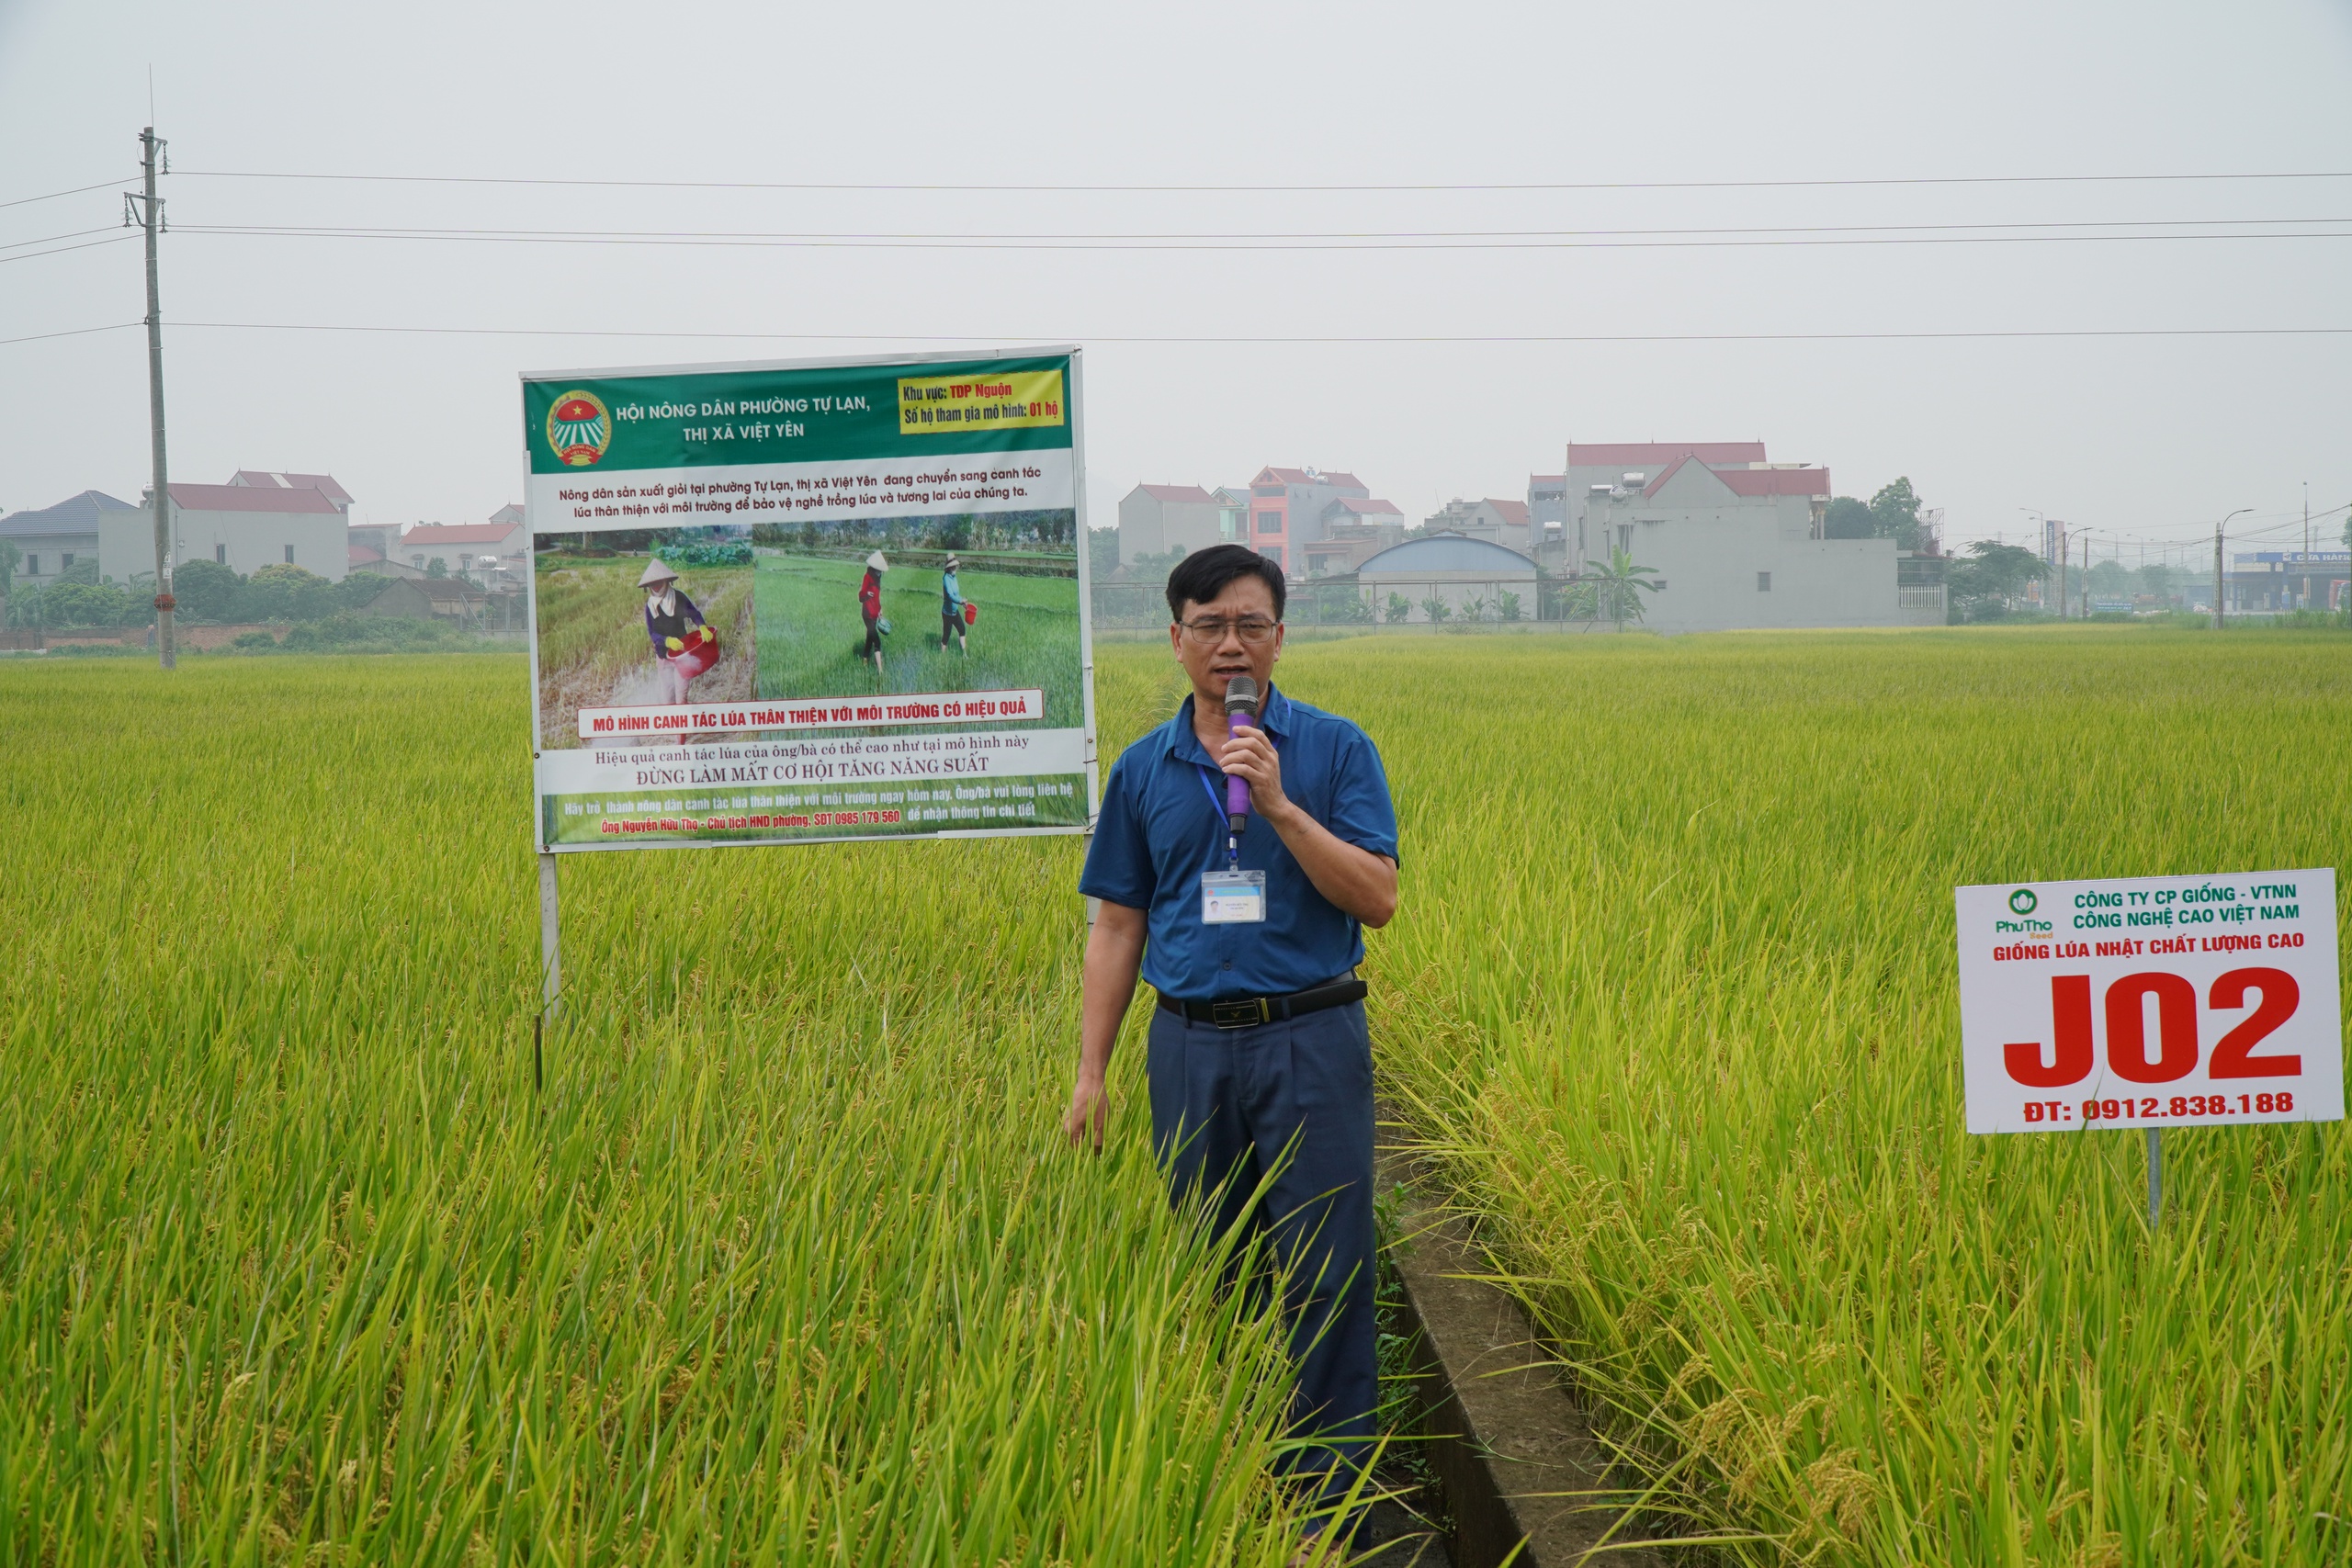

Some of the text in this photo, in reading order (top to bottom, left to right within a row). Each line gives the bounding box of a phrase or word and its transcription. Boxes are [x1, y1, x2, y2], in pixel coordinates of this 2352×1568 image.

[904, 382, 1012, 402] Khu vực: TDP Nguộn
[616, 396, 870, 423] HỘI NÔNG DÂN PHƯỜNG TỰ LẠN,
[905, 400, 1058, 425] Số hộ tham gia mô hình: 01 hộ
[684, 420, 804, 444] THỊ XÃ VIỆT YÊN
[560, 467, 1041, 502] Nông dân sản xuất giỏi tại phường Tự Lạn, thị xã Việt Yên đang chuyển sang canh tác
[574, 487, 1027, 517] lúa thân thiện với môi trường để bảo vệ nghề trồng lúa và tương lai của chúng ta.
[594, 696, 1026, 732] MÔ HÌNH CANH TÁC LÚA THÂN THIỆN VỚI MÔI TRƯỜNG CÓ HIỆU QUẢ
[595, 736, 1029, 767] Hiệu quả canh tác lúa của ông/bà có thể cao như tại mô hình này
[637, 751, 989, 785] ĐỪNG LÀM MẤT CƠ HỘI TĂNG NĂNG SUẤT
[565, 803, 582, 816] Hãy
[606, 802, 633, 813] thành
[638, 800, 661, 812] nông
[664, 799, 683, 811] dân
[686, 798, 709, 810] canh
[713, 796, 729, 809] tác
[732, 796, 747, 808] lúa
[751, 795, 772, 807] thân
[776, 795, 800, 808] thiện
[804, 794, 819, 806] với
[823, 793, 842, 806] môi
[845, 792, 876, 806] trường
[880, 791, 904, 807] ngay
[908, 790, 929, 802] hôm
[602, 810, 900, 834] Ông Nguyễn Hữu Thọ Chủ tịch HND phường, SĐT 0985 179 560
[2075, 882, 2297, 908] CÔNG TY CP GIỐNG VTNN
[1996, 919, 2052, 933] PhuTho
[2074, 904, 2300, 929] CÔNG NGHỆ CAO VIỆT NAM
[1993, 932, 2304, 961] GIỐNG LÚA NHẬT CHẤT LƯỢNG CAO
[2004, 967, 2301, 1088] J02
[2023, 1092, 2293, 1122] ĐT: 0912.838.188
